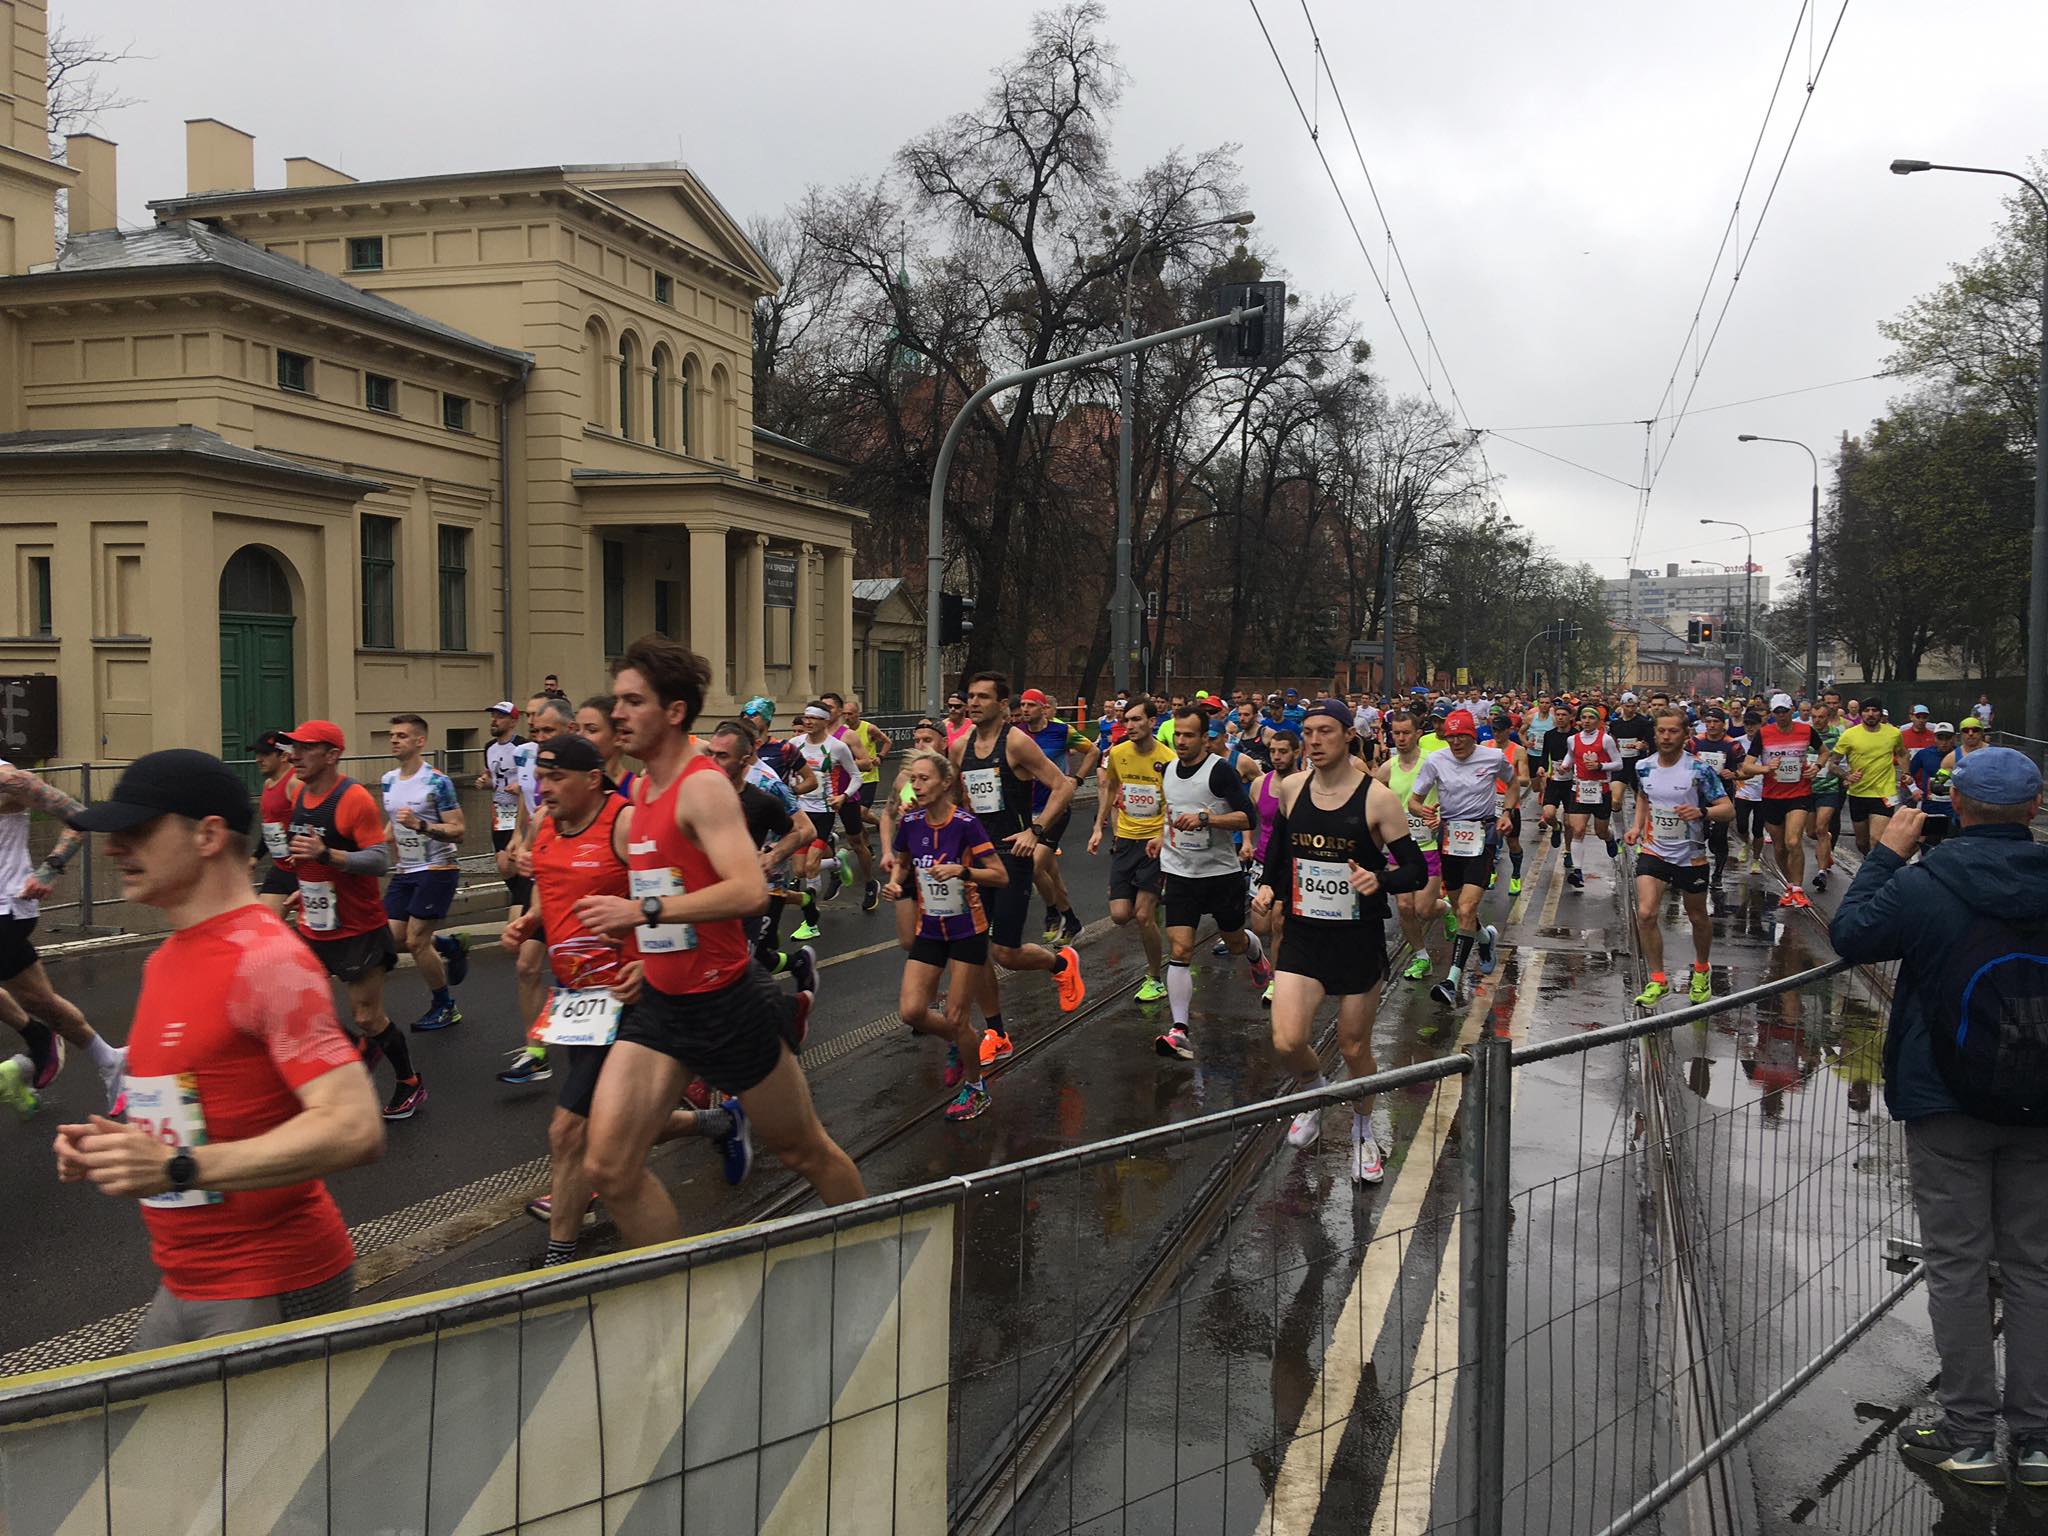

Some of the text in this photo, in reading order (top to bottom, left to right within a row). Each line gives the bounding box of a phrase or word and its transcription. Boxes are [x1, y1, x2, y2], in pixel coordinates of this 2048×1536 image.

[1778, 764, 1798, 773] 4185
[970, 782, 995, 795] 6903
[1582, 787, 1598, 795] 1662
[1128, 794, 1154, 805] 3990
[1654, 815, 1680, 827] 7337
[1291, 832, 1357, 850] SWORDS
[1454, 830, 1475, 841] 992
[928, 883, 950, 896] 178
[1305, 878, 1350, 895] 8408
[1311, 908, 1343, 917] POZNAŃ
[563, 998, 607, 1018] 6071
